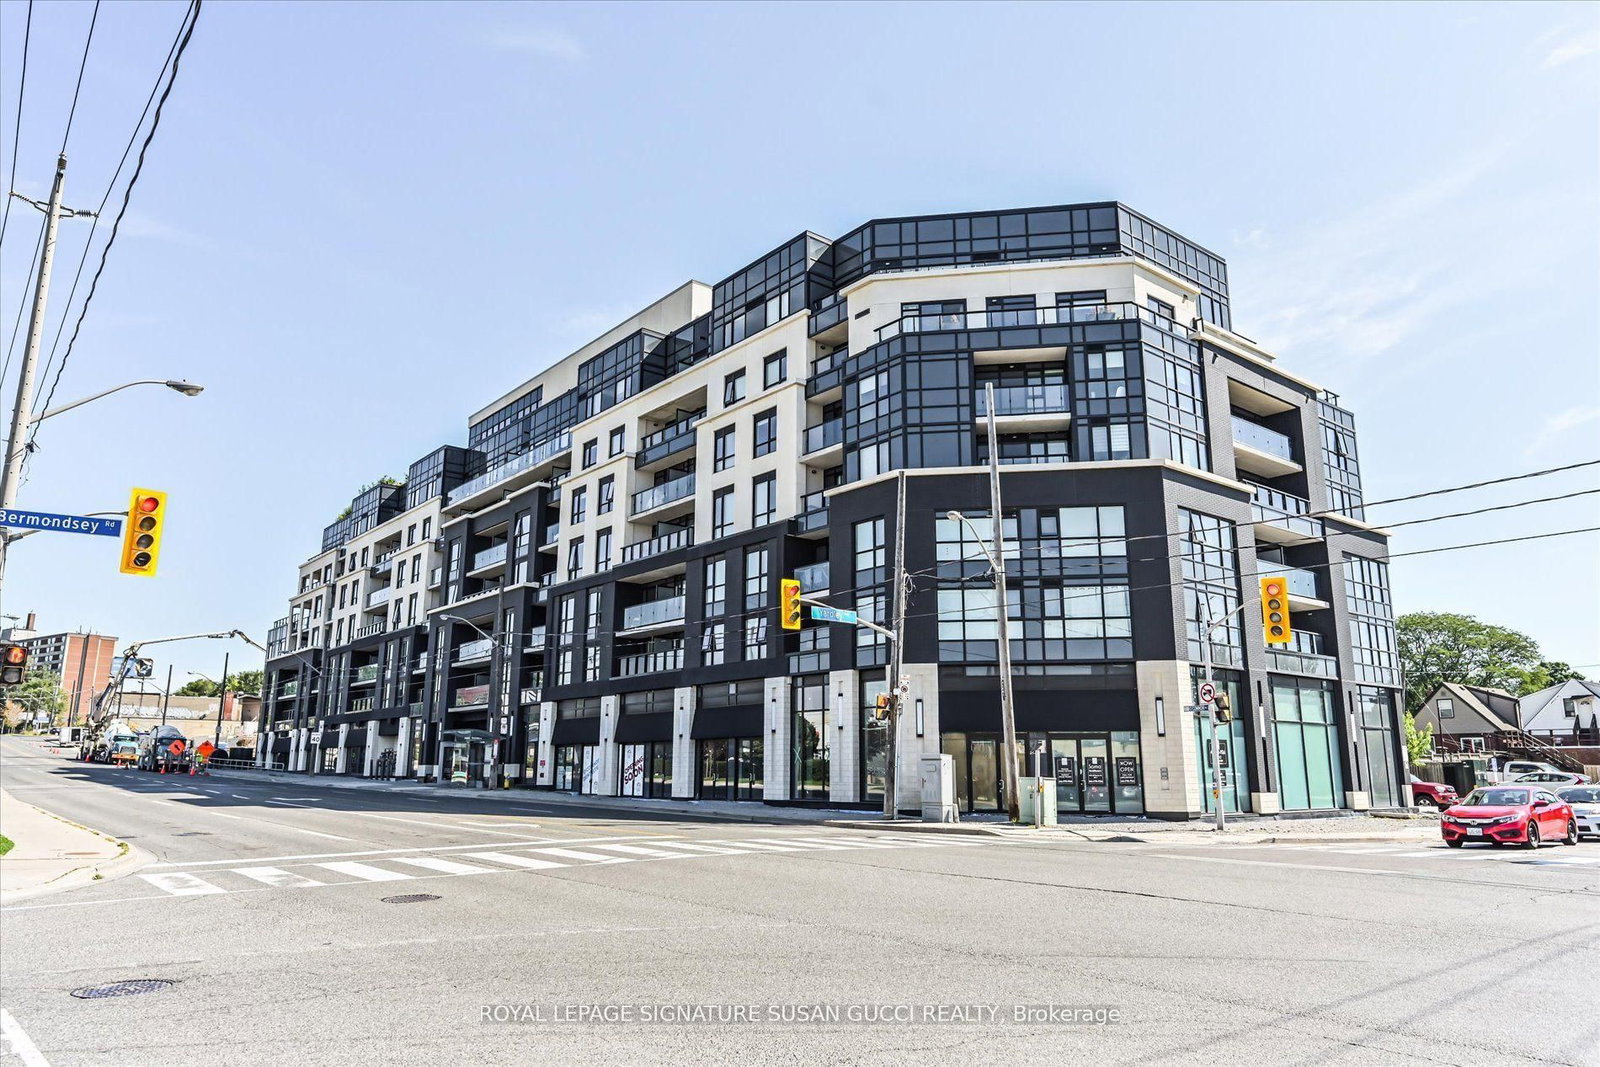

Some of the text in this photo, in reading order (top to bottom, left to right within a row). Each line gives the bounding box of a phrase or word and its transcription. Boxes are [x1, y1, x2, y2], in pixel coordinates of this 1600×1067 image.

[0, 510, 99, 533] Bermondsey
[624, 755, 645, 775] OPENING
[624, 765, 643, 784] SOON
